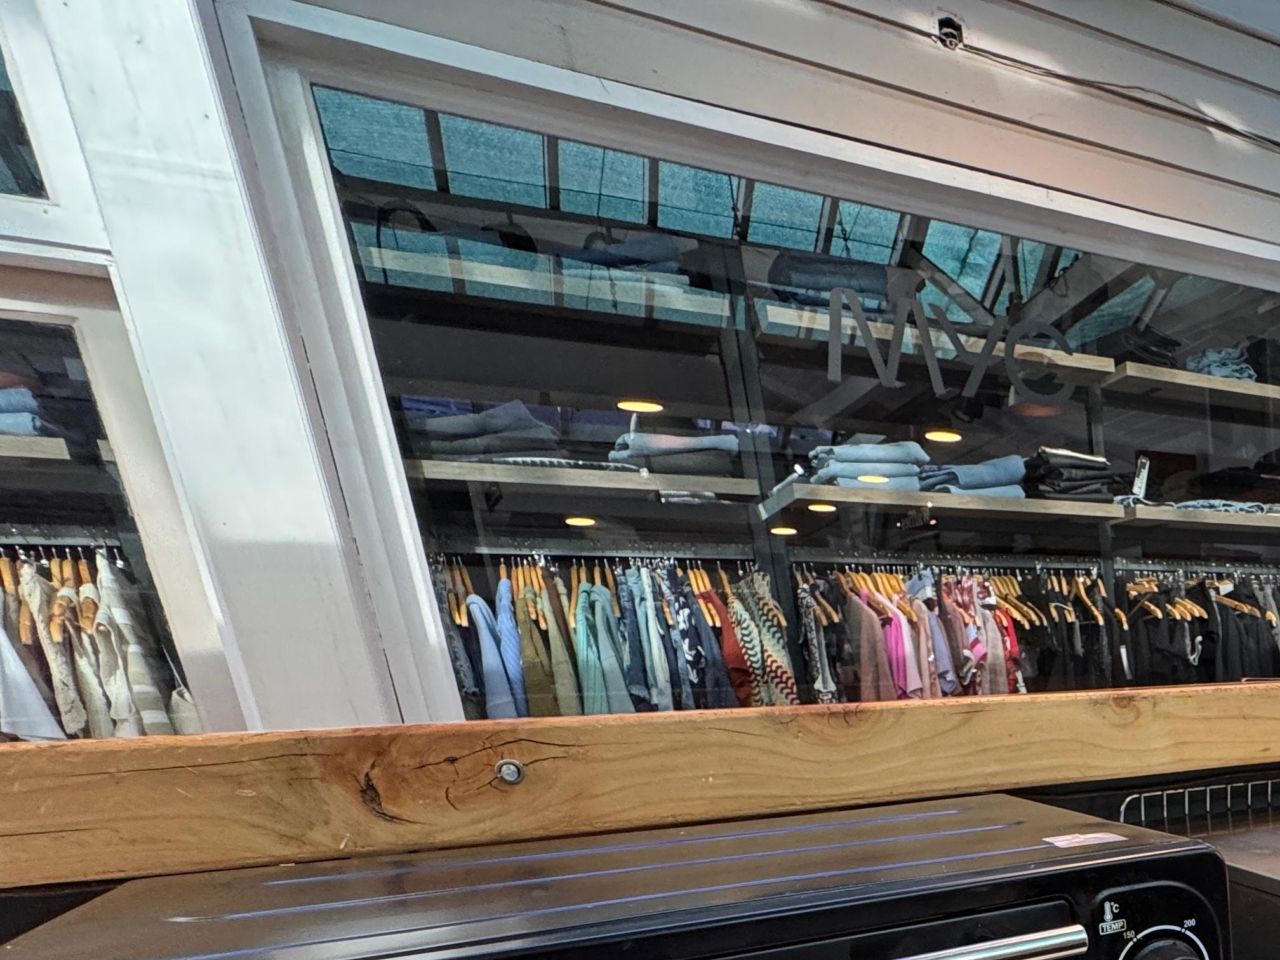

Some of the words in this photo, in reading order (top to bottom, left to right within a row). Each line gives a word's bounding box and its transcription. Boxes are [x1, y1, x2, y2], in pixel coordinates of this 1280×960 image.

[1101, 921, 1124, 934] TEMP
[1183, 919, 1196, 928] 200
[1123, 930, 1136, 939] 150
